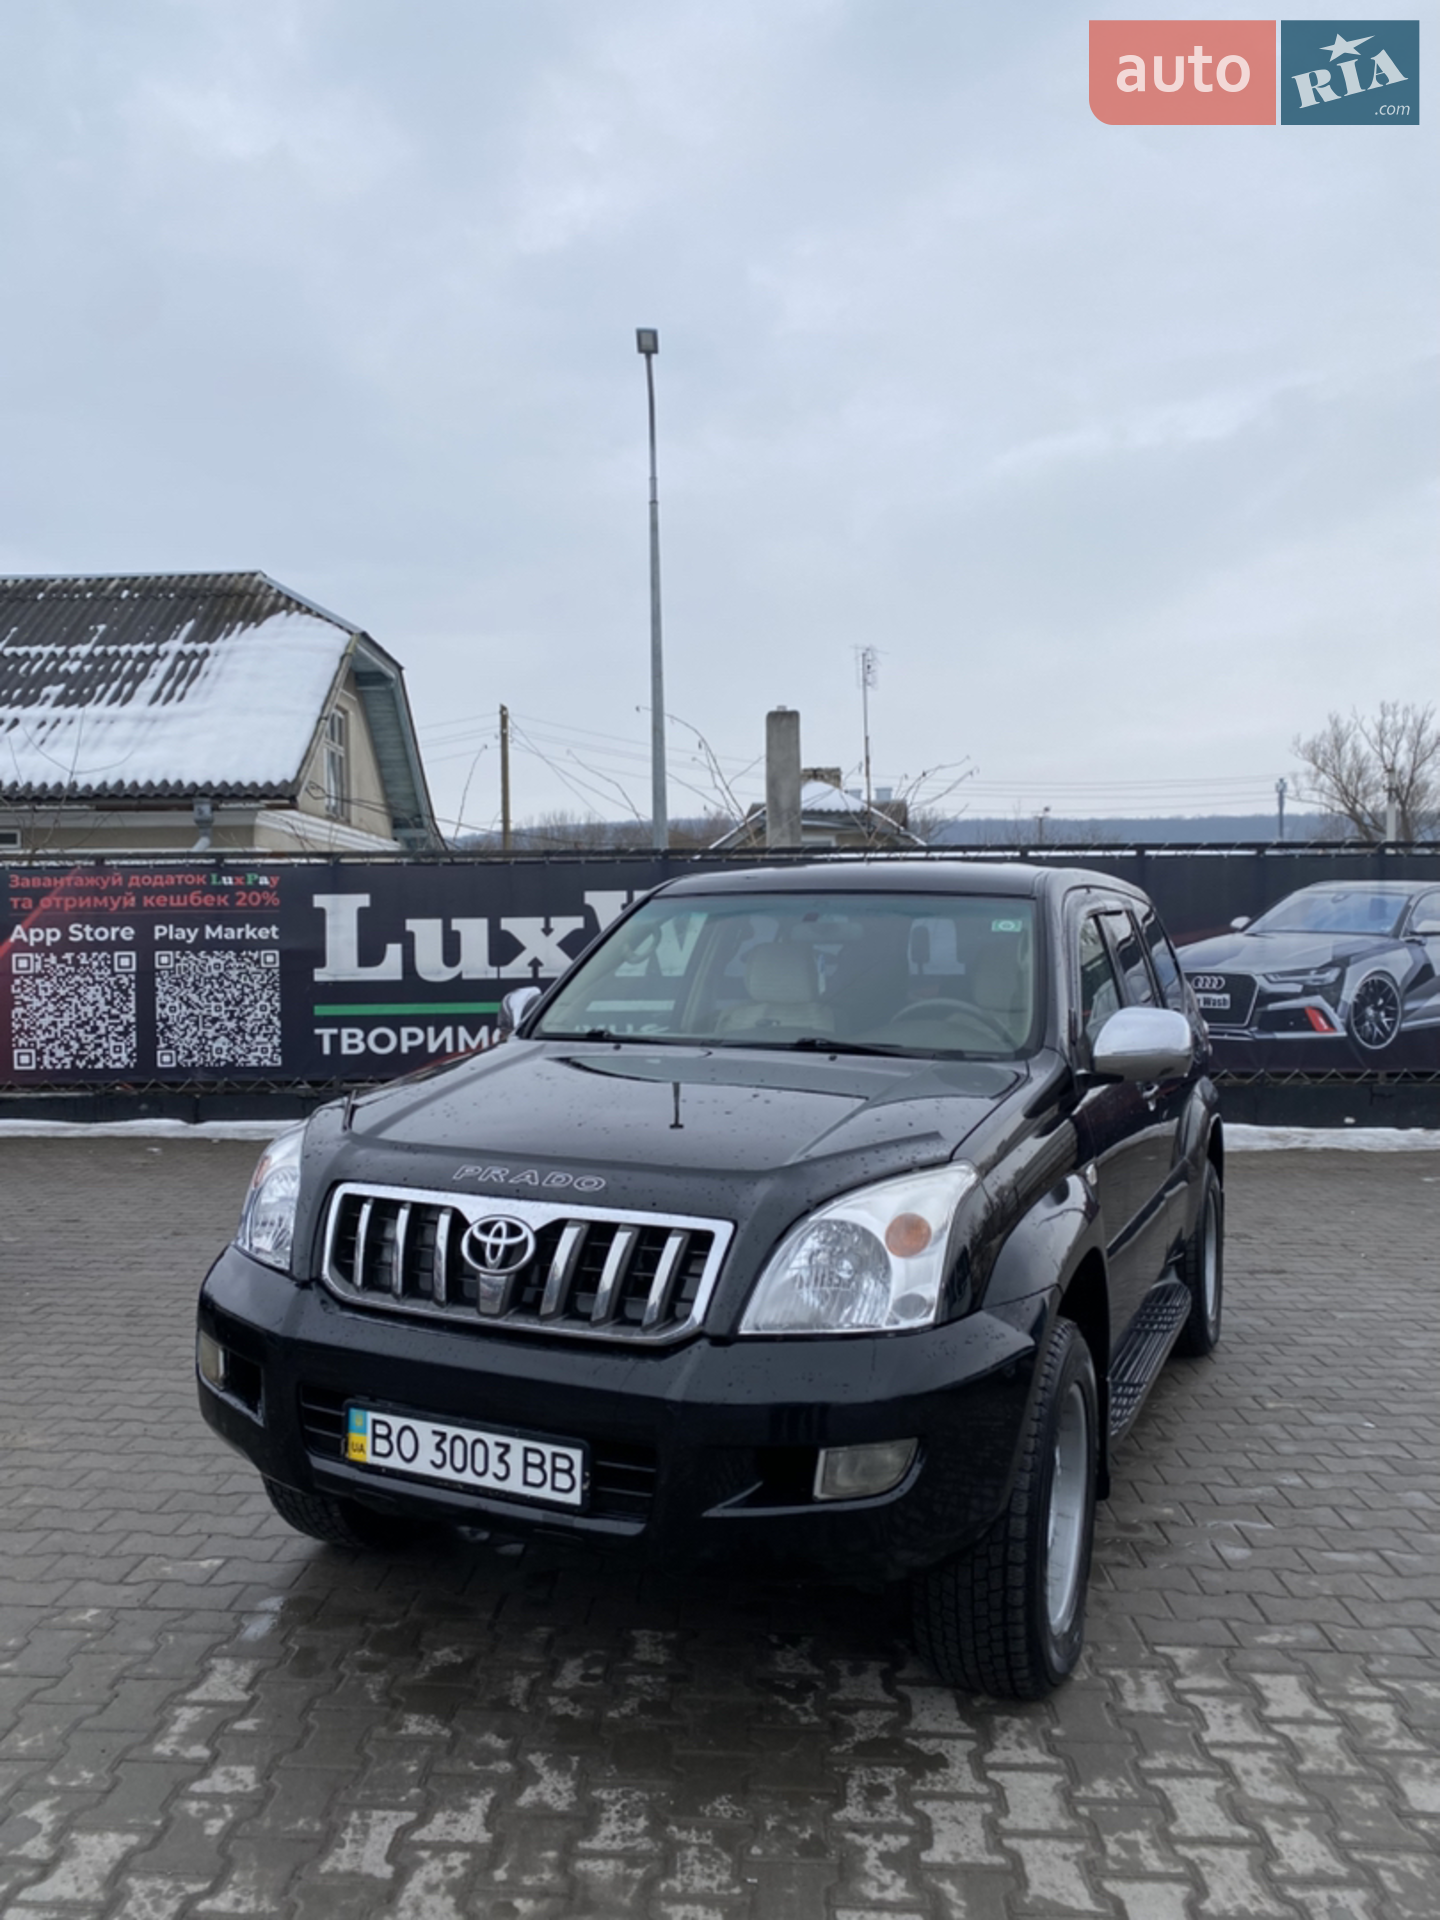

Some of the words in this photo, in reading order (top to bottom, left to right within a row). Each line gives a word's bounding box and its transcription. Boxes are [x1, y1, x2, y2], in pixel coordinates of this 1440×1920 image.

[9, 871, 123, 890] Завантажуй
[128, 873, 207, 889] додаток
[210, 873, 280, 888] LuxPay
[9, 897, 33, 909] та
[39, 891, 136, 912] отримуй
[142, 890, 230, 907] кешбек
[235, 891, 280, 906] 20%
[10, 924, 62, 946] App
[68, 923, 136, 942] Store
[154, 924, 199, 944] Play
[204, 923, 280, 940] Market
[314, 1025, 502, 1056] ТВОРИМ
[452, 1164, 606, 1192] PRADO
[371, 1418, 419, 1463] BO
[430, 1430, 511, 1481] 3003
[522, 1446, 577, 1494] BB
